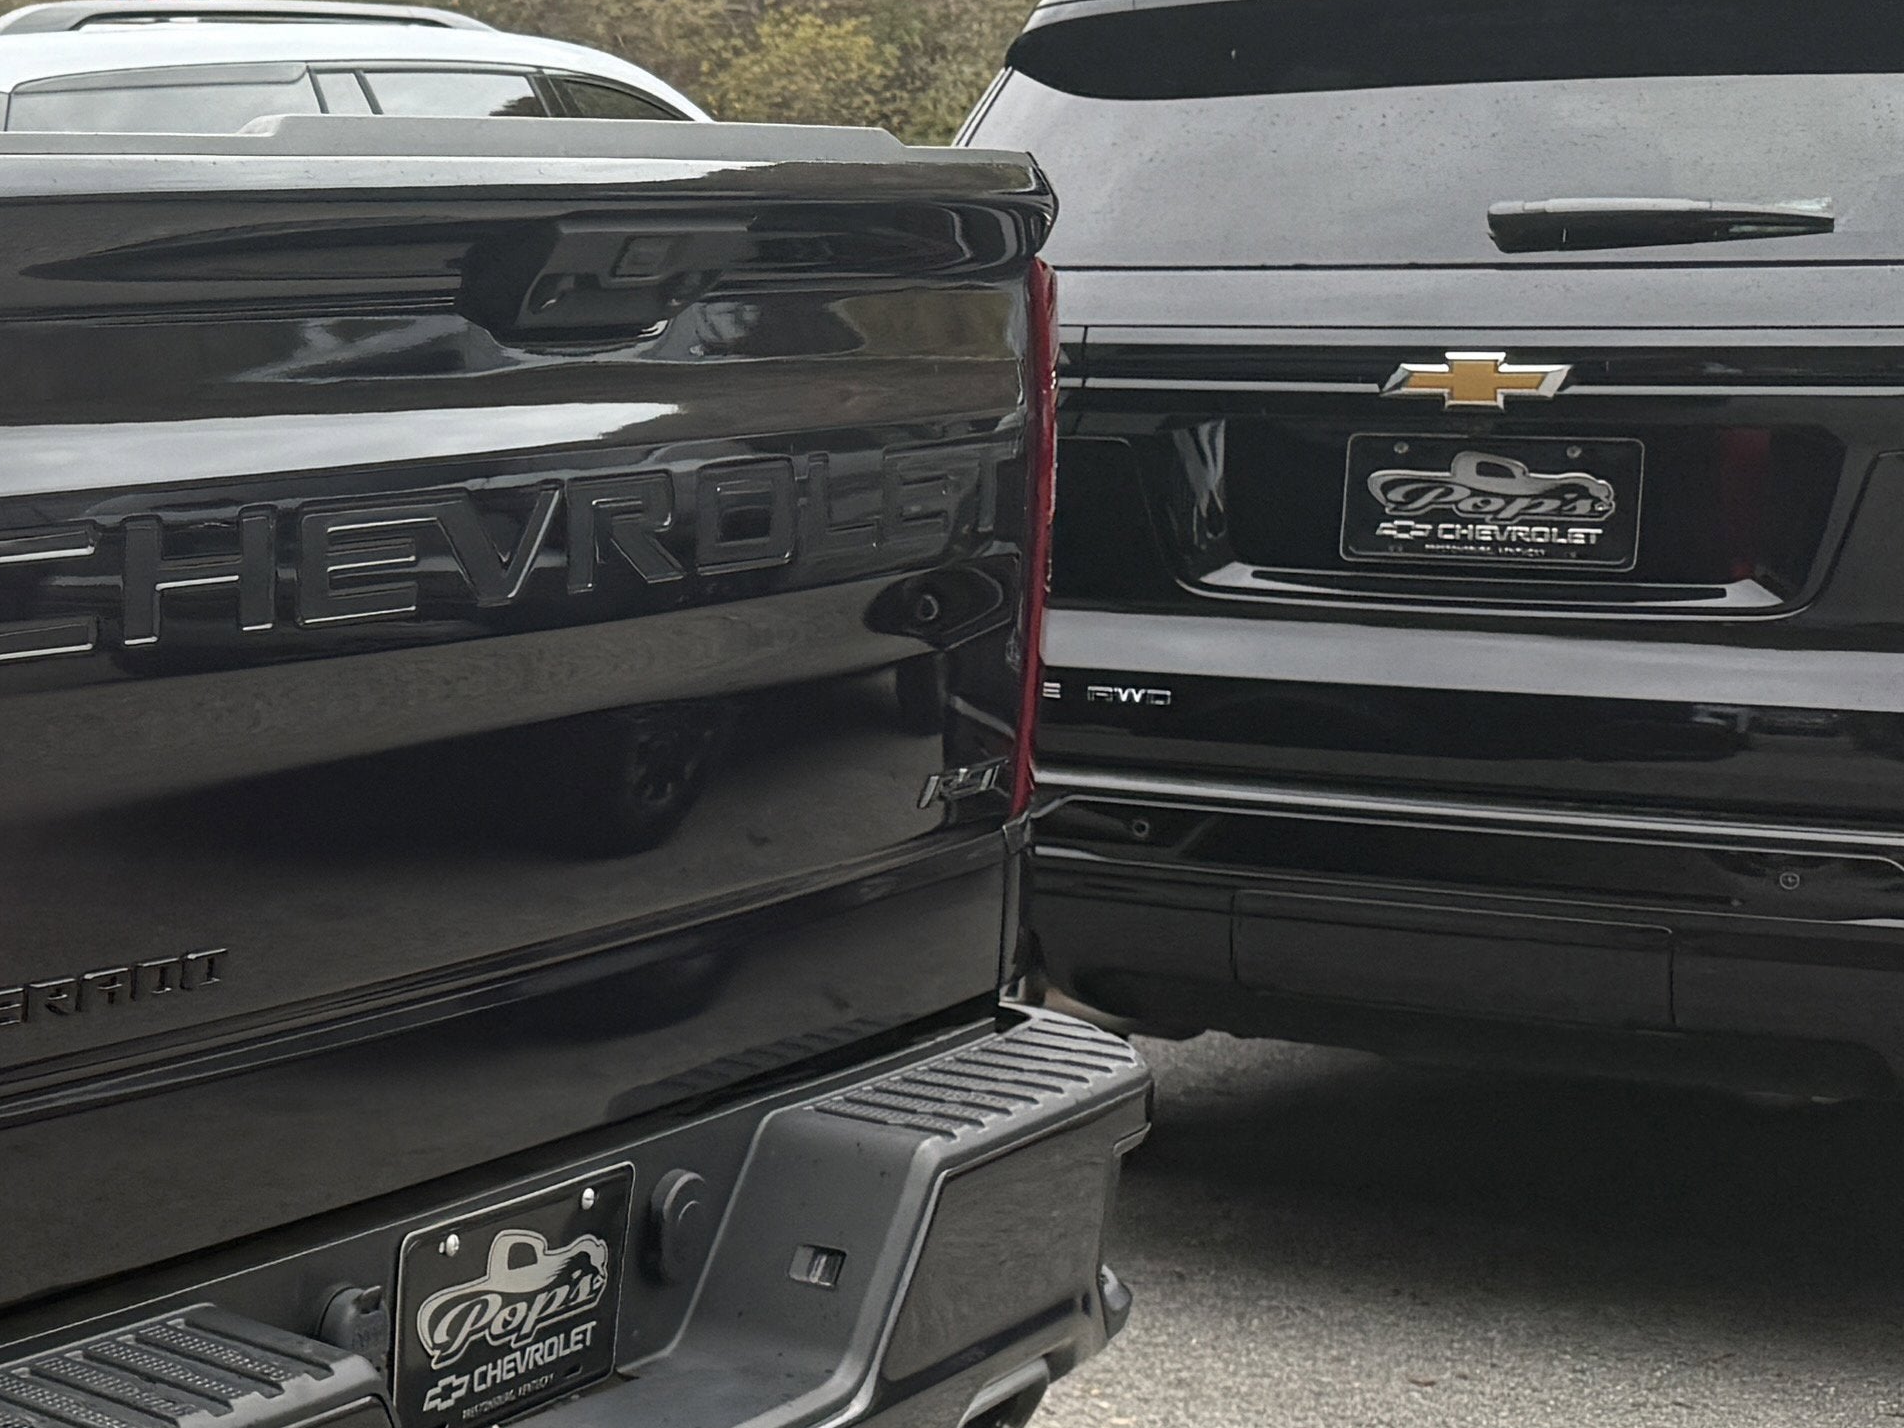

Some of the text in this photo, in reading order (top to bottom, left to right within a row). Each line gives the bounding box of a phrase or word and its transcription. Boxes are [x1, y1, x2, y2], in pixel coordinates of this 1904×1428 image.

[1436, 523, 1605, 546] CHEVROLET
[1086, 684, 1172, 706] AWD
[473, 1321, 596, 1392] CHEVROLET
